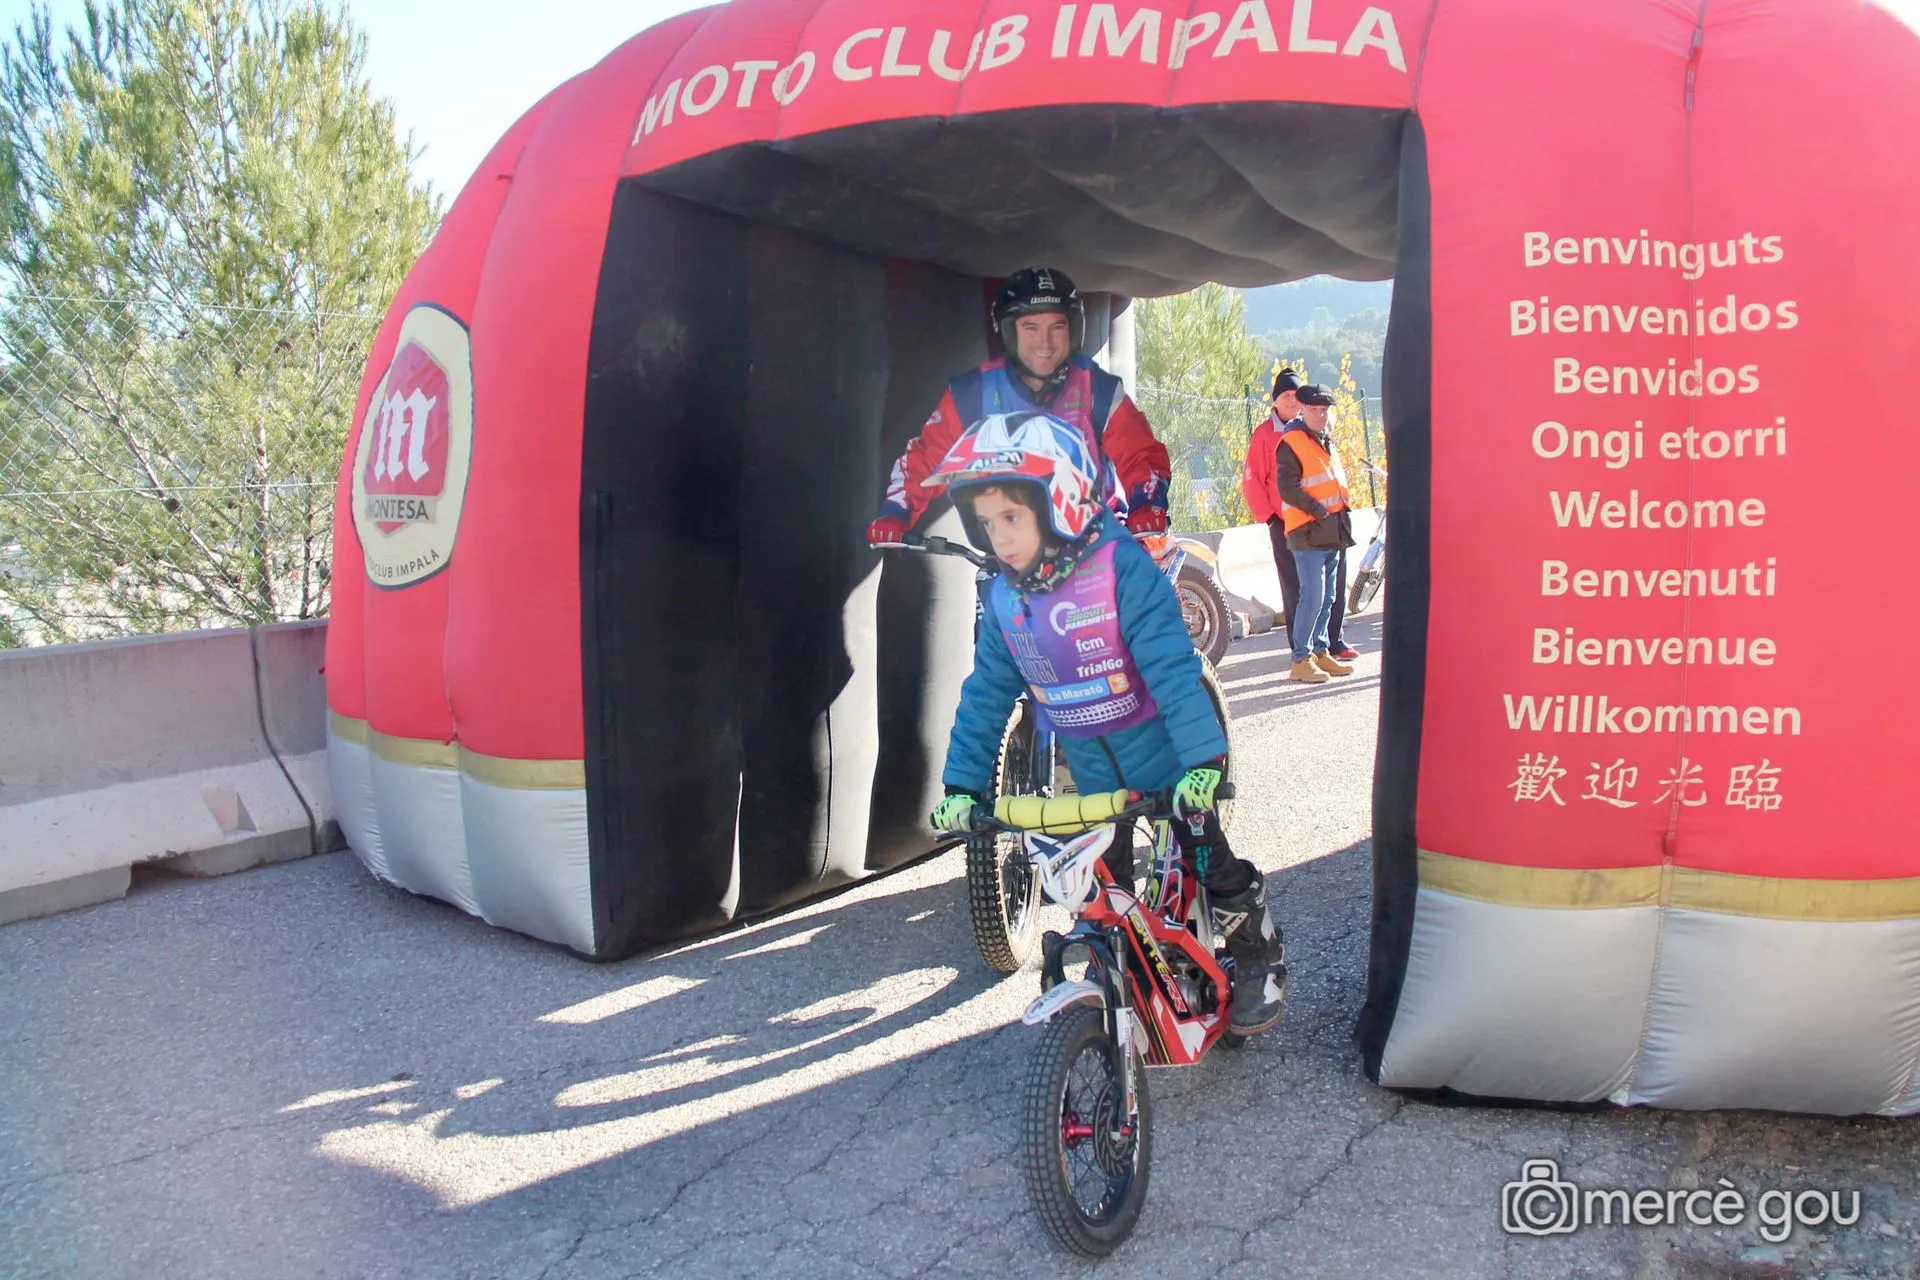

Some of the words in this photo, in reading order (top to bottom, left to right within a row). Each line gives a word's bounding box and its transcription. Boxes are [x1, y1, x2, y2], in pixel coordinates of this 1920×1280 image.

[632, 51, 815, 146] MOTO
[833, 15, 1029, 81] CLUB
[1051, 0, 1407, 72] IMPALA
[1523, 229, 1784, 279] Benvinguts
[1510, 294, 1799, 336] Bienvenidos
[1553, 357, 1760, 396] Benvidos
[1531, 420, 1643, 469] Ongi
[1659, 416, 1786, 460] etorri
[1549, 489, 1766, 528] Welcome
[396, 548, 440, 578] IMPALA
[1541, 557, 1777, 598] Benvenuti
[1075, 637, 1105, 653] fcm
[1532, 627, 1777, 666] Bienvenue
[1076, 658, 1124, 678] TrialGo
[1503, 694, 1801, 735] Willkommen
[1506, 753, 1783, 811] 歡迎光臨
